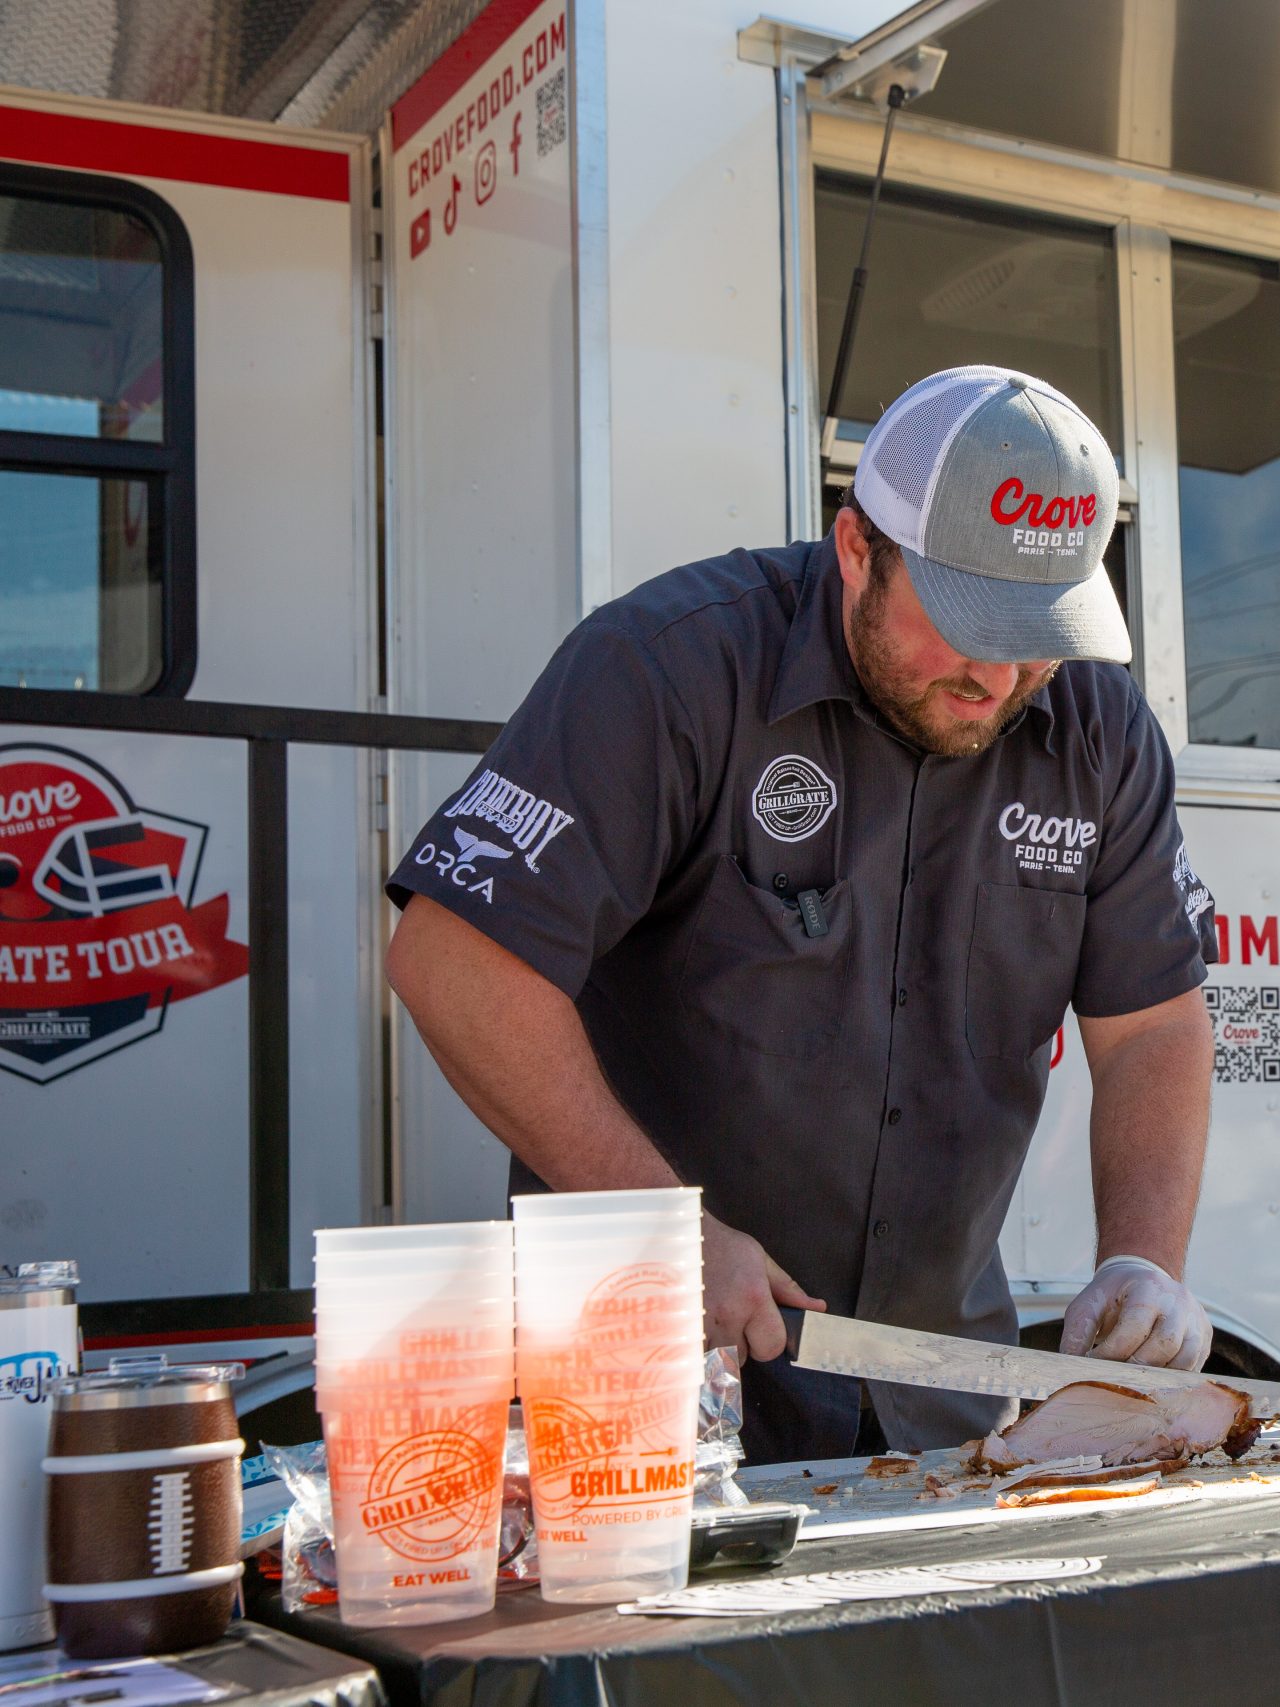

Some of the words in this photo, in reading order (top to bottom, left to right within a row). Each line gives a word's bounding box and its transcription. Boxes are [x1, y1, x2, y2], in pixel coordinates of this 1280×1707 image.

[408, 12, 566, 198] CROVEFOOD.COM
[991, 477, 1097, 529] Crove
[1012, 528, 1062, 546] FOOD
[1067, 530, 1084, 546] CO
[1018, 546, 1045, 555] PARIS
[998, 802, 1097, 848] Crove
[1015, 844, 1058, 863] FOOD
[1062, 850, 1083, 865] CO
[415, 843, 494, 904] ORCA
[1019, 860, 1043, 871] PARIS
[1053, 863, 1076, 874] TENN.
[77, 922, 195, 979] TOUR
[1223, 1024, 1260, 1040] Crove
[572, 1511, 642, 1526] POWERED
[646, 1509, 661, 1521] BY
[551, 1530, 588, 1542] WELL
[393, 1574, 426, 1587] EAT
[429, 1568, 472, 1585] WELL
